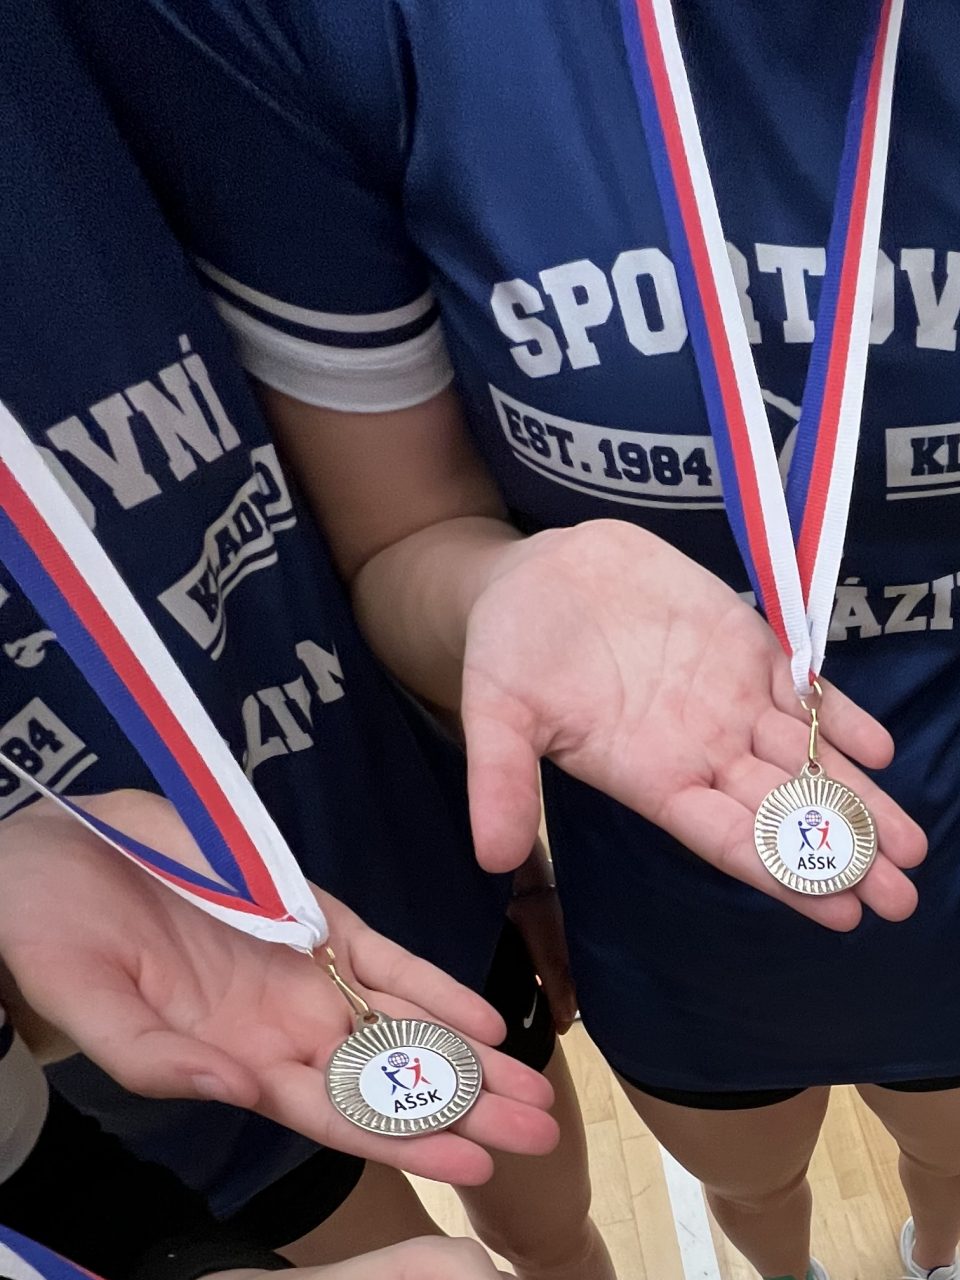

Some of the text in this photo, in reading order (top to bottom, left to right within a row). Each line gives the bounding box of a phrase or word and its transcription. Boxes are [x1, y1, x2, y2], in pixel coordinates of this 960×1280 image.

[501, 401, 713, 487] EST. 1984
[798, 853, 837, 870] AŠSK
[394, 1088, 442, 1113] AŠSK
